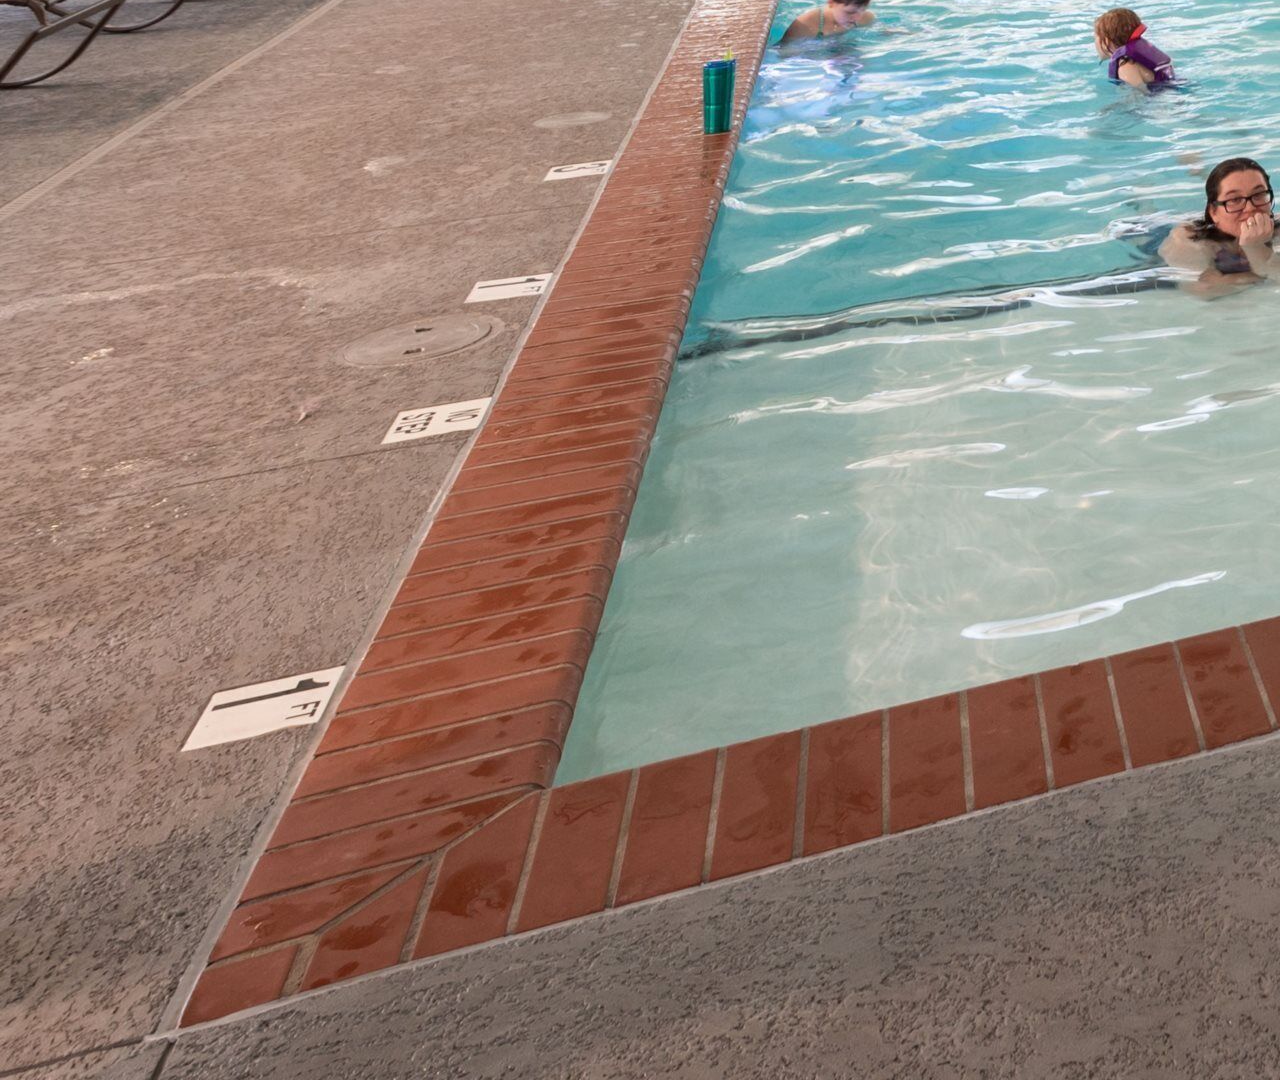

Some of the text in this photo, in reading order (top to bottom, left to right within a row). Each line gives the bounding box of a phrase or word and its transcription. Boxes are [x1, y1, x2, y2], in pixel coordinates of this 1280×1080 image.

[393, 412, 436, 434] STEP
[445, 408, 482, 423] NO
[285, 700, 321, 719] FT
